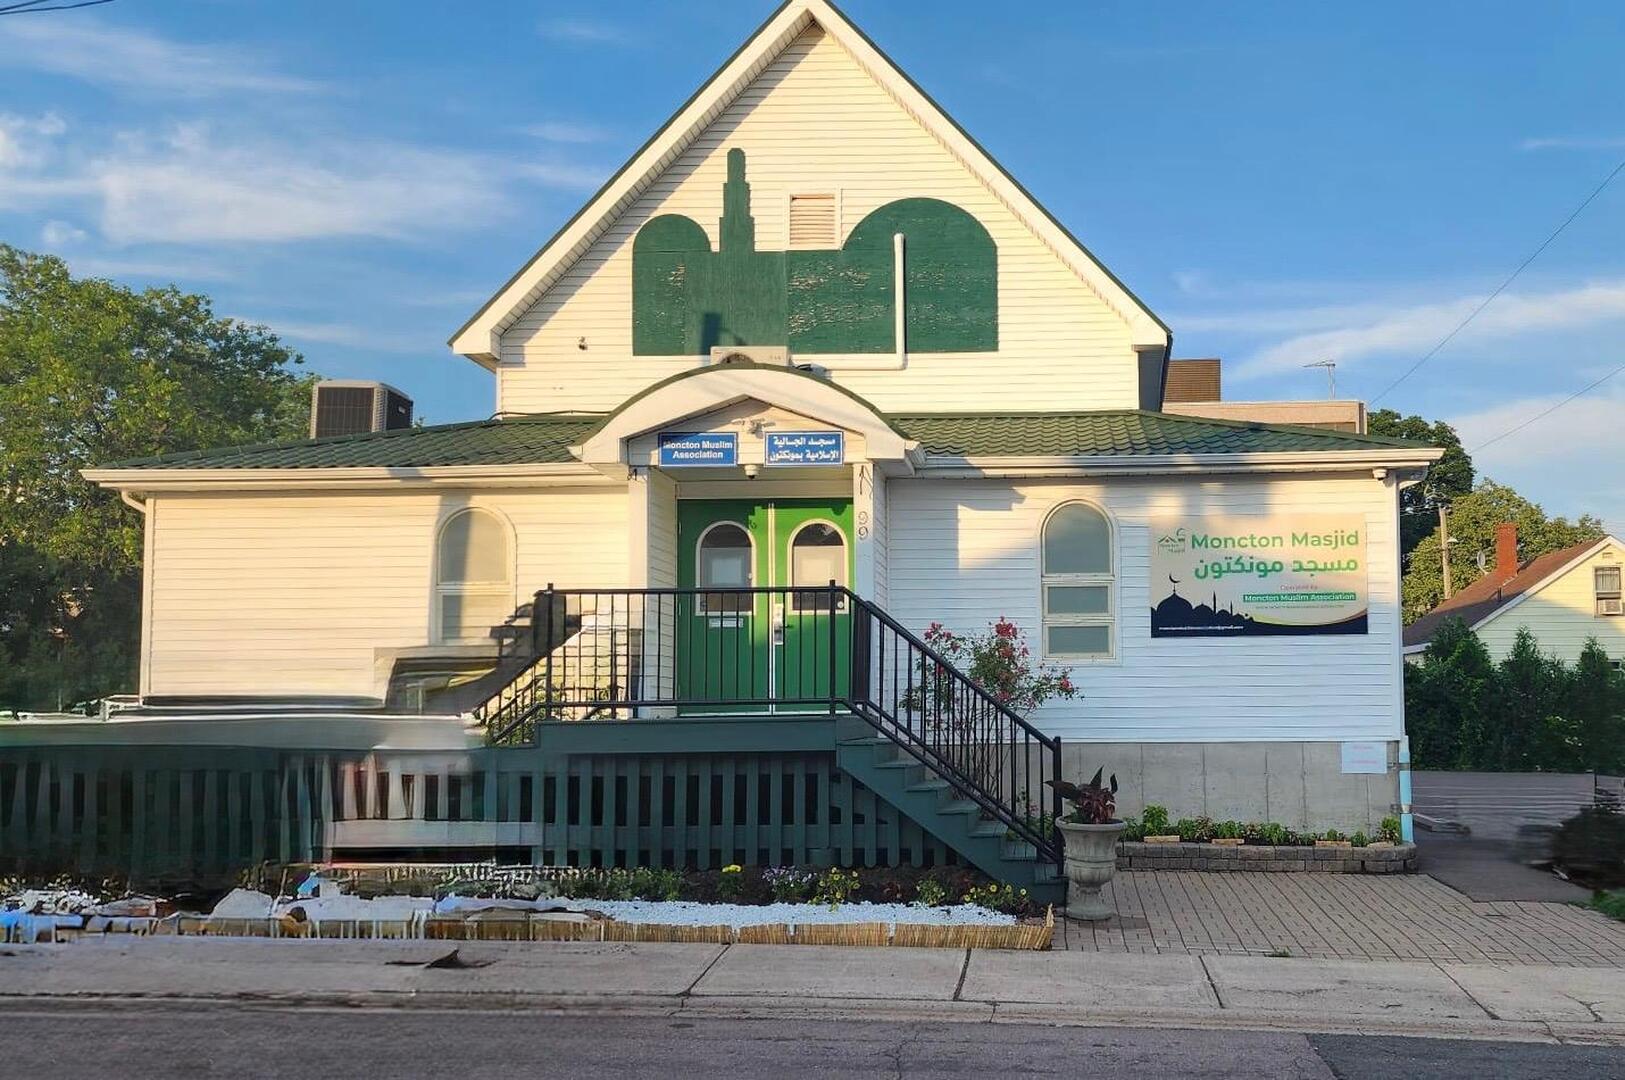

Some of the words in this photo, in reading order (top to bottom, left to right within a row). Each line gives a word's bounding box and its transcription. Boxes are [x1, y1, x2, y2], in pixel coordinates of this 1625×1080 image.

[701, 440, 733, 449] Muslim
[773, 436, 806, 448] الجالية
[672, 450, 724, 459] Association
[1191, 533, 1284, 550] Moncton
[1291, 530, 1359, 550] Masjid
[1194, 556, 1284, 580] مونكتون
[1292, 557, 1358, 578] مسجد
[1244, 594, 1279, 602] Moncton
[1280, 593, 1309, 601] Muslim
[1310, 592, 1355, 600] Association
